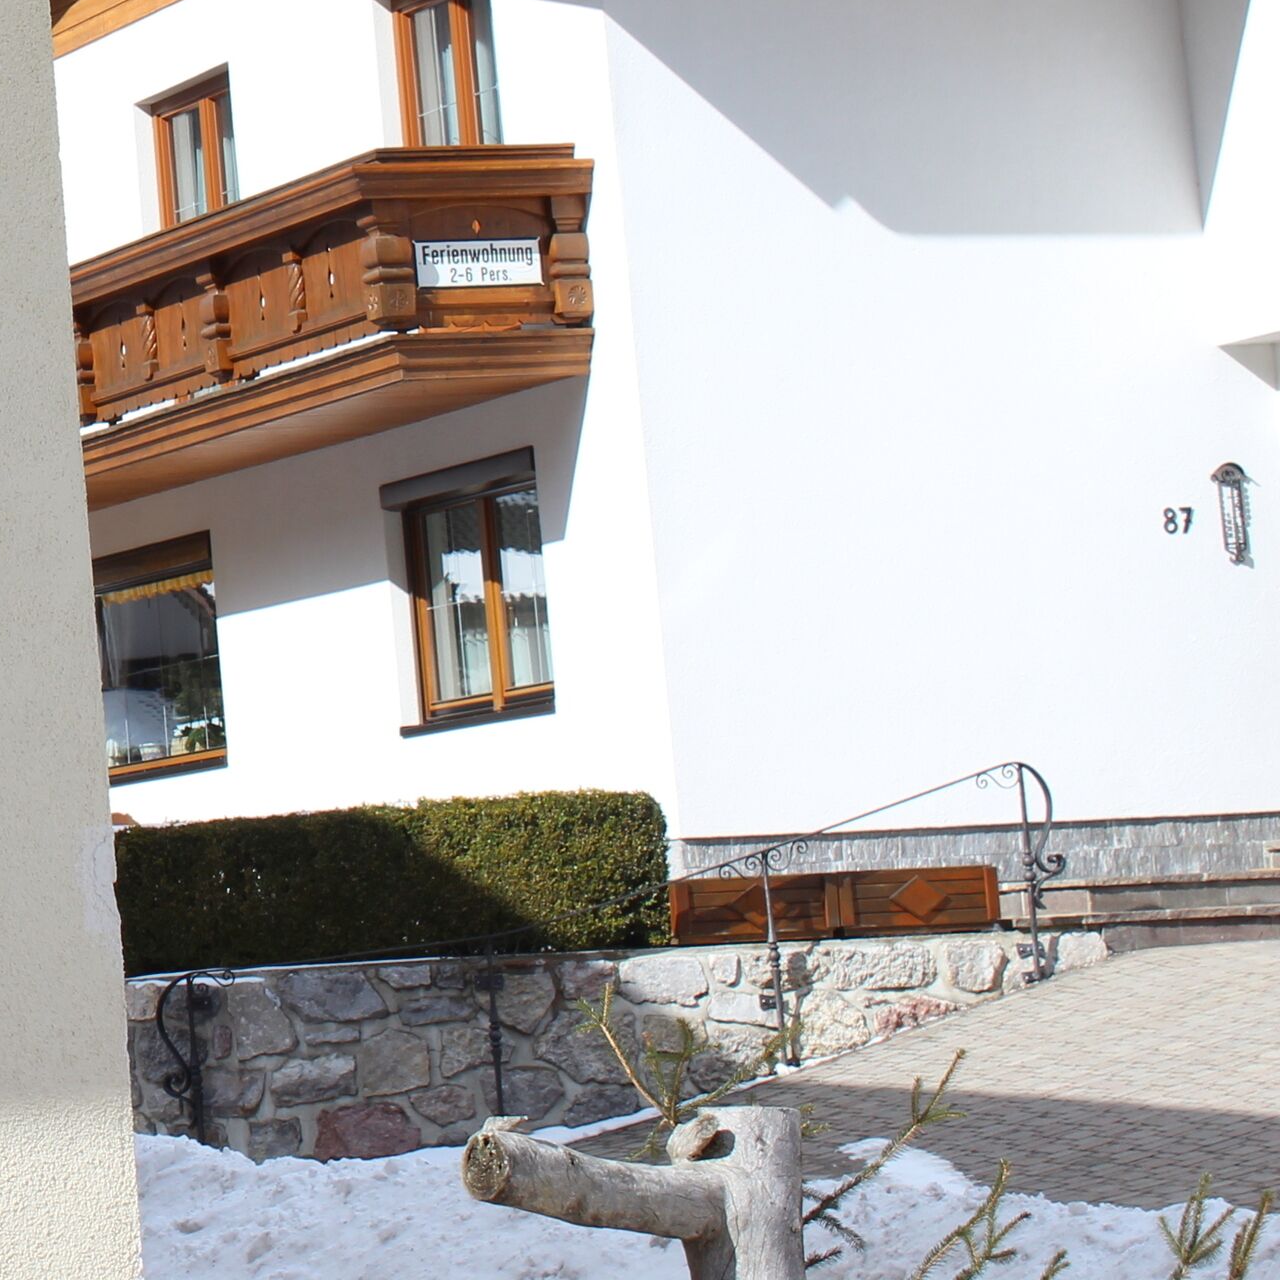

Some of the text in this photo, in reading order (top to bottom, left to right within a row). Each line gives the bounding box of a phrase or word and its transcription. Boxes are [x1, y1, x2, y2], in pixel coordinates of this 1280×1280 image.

[421, 244, 533, 266] Ferienwohnung
[450, 267, 513, 283] 2-6 Pers.
[1163, 506, 1193, 535] 87
